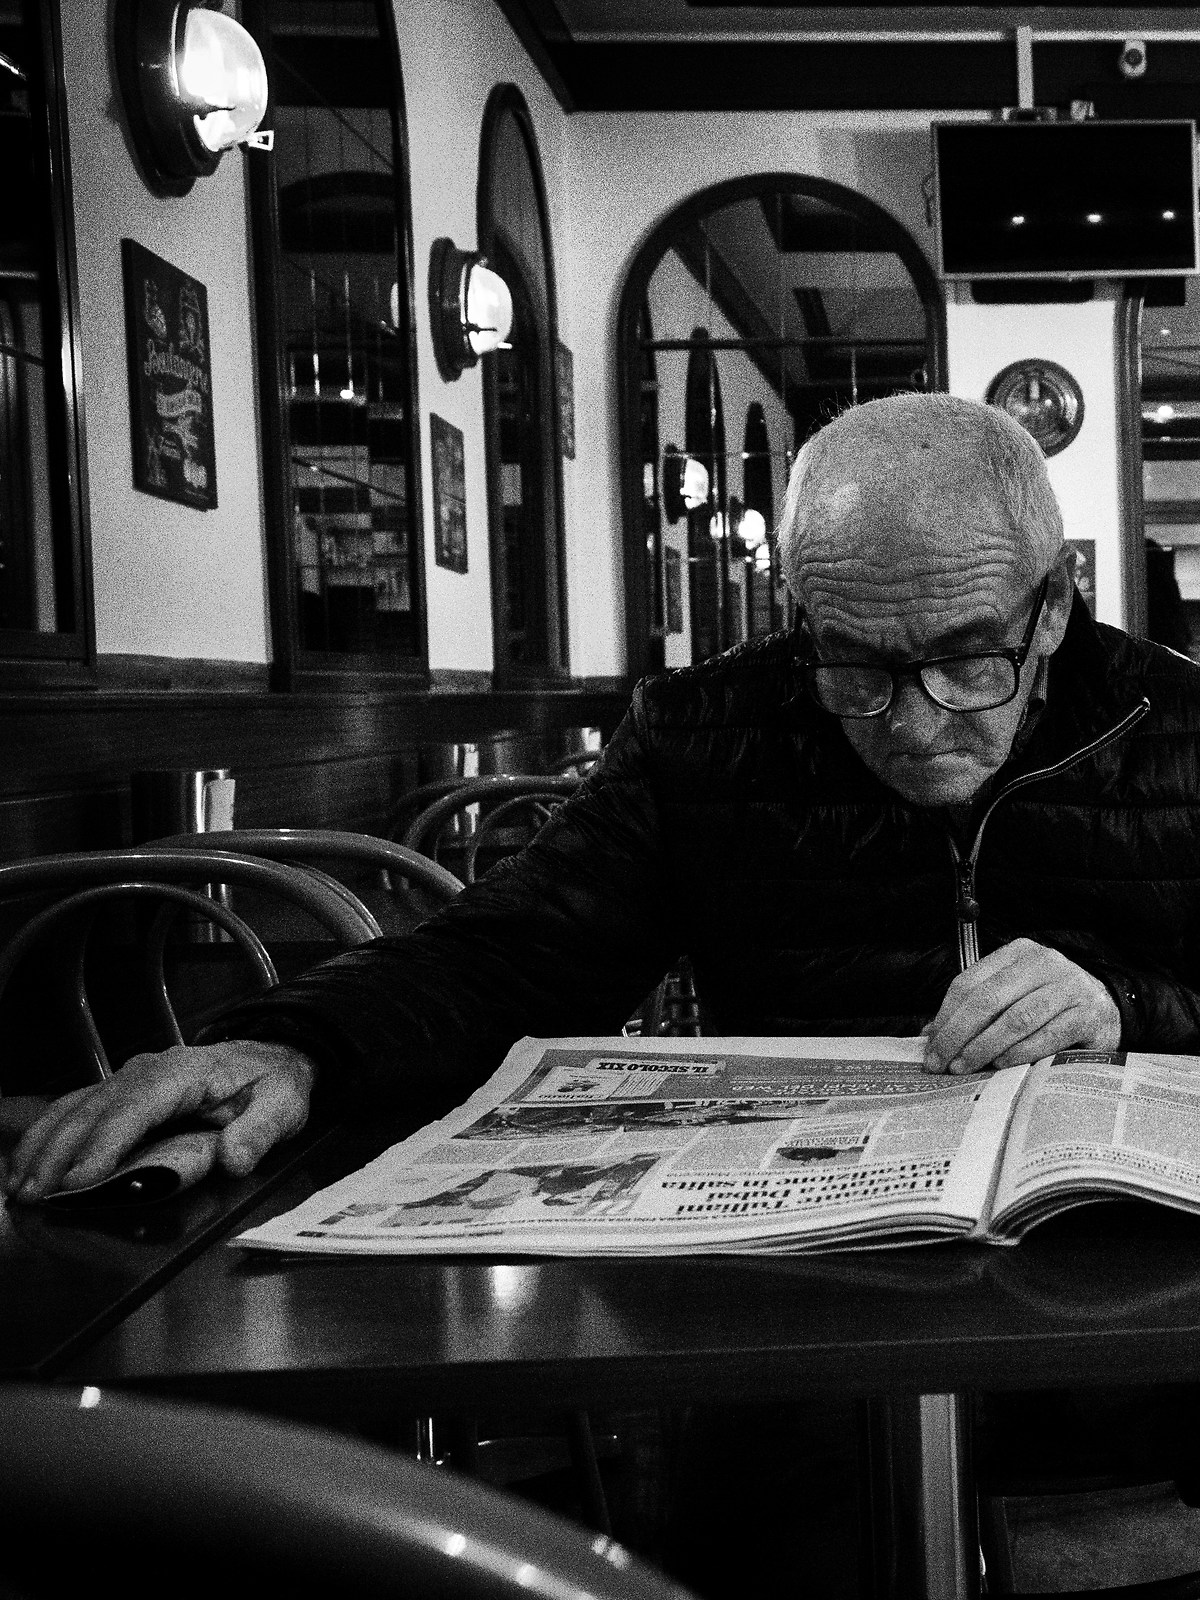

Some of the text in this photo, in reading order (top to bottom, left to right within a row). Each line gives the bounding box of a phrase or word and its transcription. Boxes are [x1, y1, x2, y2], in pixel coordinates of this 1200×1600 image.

[596, 1062, 627, 1071] XIX
[627, 1064, 690, 1073] SECOLO
[661, 1181, 737, 1191] salita
[742, 1180, 769, 1189] in
[705, 1189, 791, 1203] Dubai
[675, 1200, 789, 1216] Tulliani
